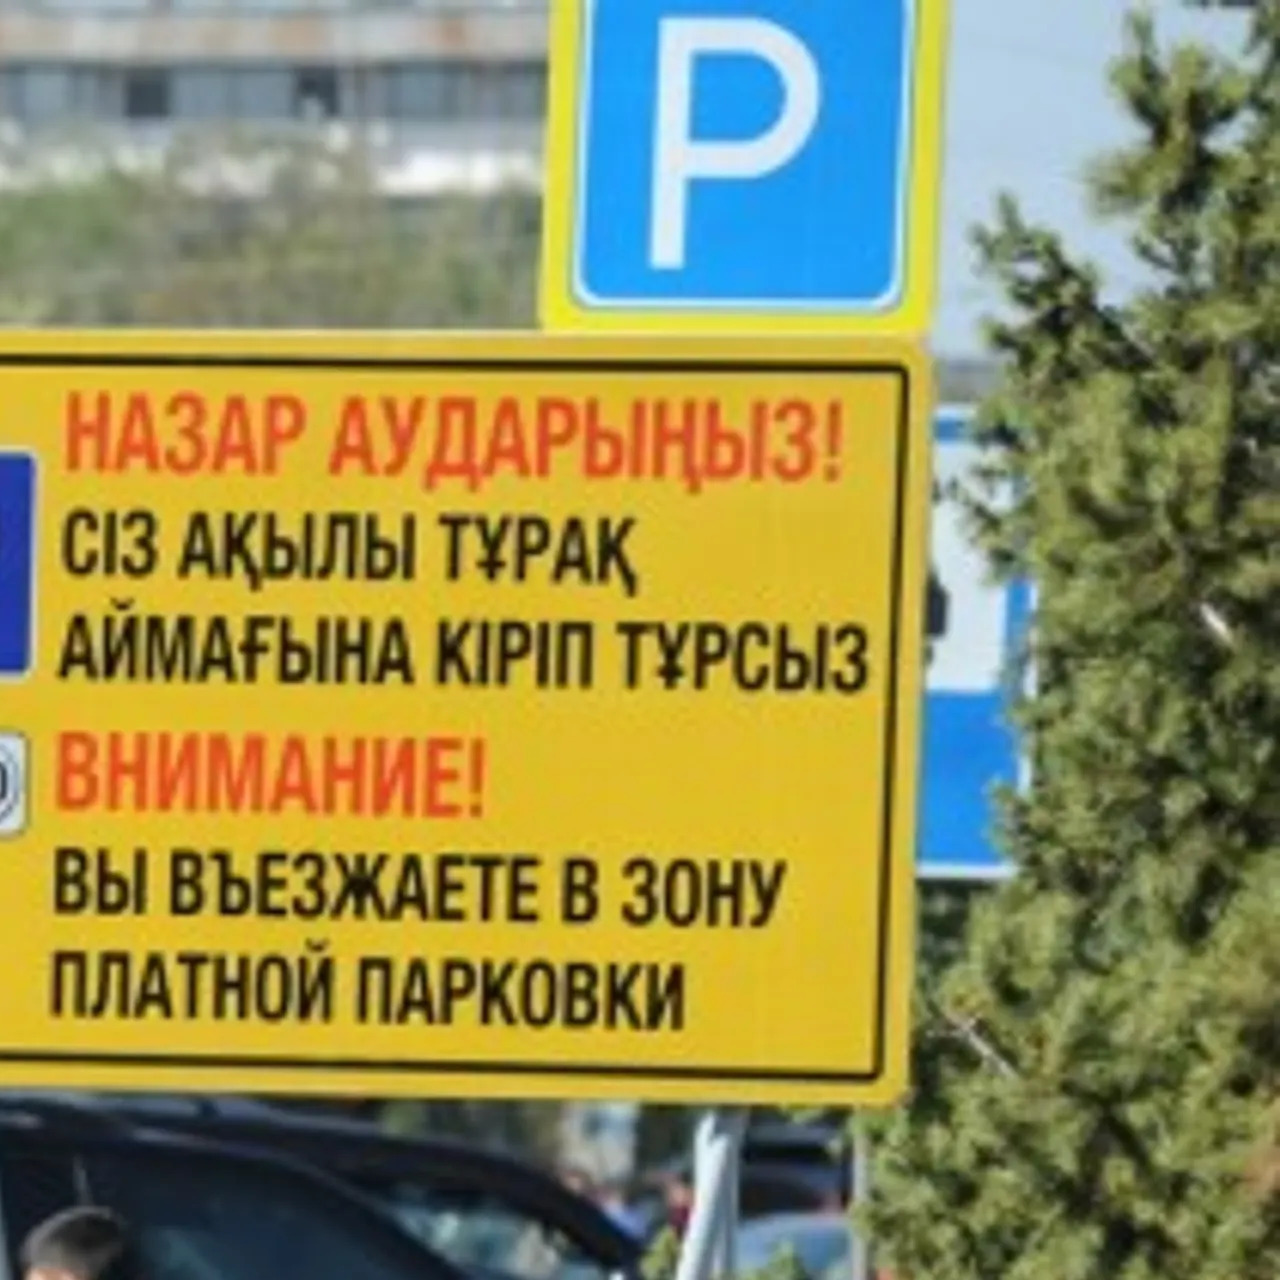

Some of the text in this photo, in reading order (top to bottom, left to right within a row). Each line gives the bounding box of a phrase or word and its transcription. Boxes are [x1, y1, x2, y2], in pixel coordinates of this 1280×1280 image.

[649, 16, 821, 270] P
[65, 391, 843, 494] НАЗАР АУДАРЫҢЫЗ!
[62, 509, 637, 597] СІЗ АҚЫЛЫ ТҰРАҚ
[58, 602, 868, 694] АЙМАҒЫНА КІРІП ТҰРСЫЗ
[55, 730, 486, 819] ВНИМАНИЕ!
[54, 847, 786, 928] ВЫ ВЪЕЗЖАЕТЕ В ЗОНУ
[52, 943, 684, 1030] ПЛАТНОЙ ПАРКОВКИ
